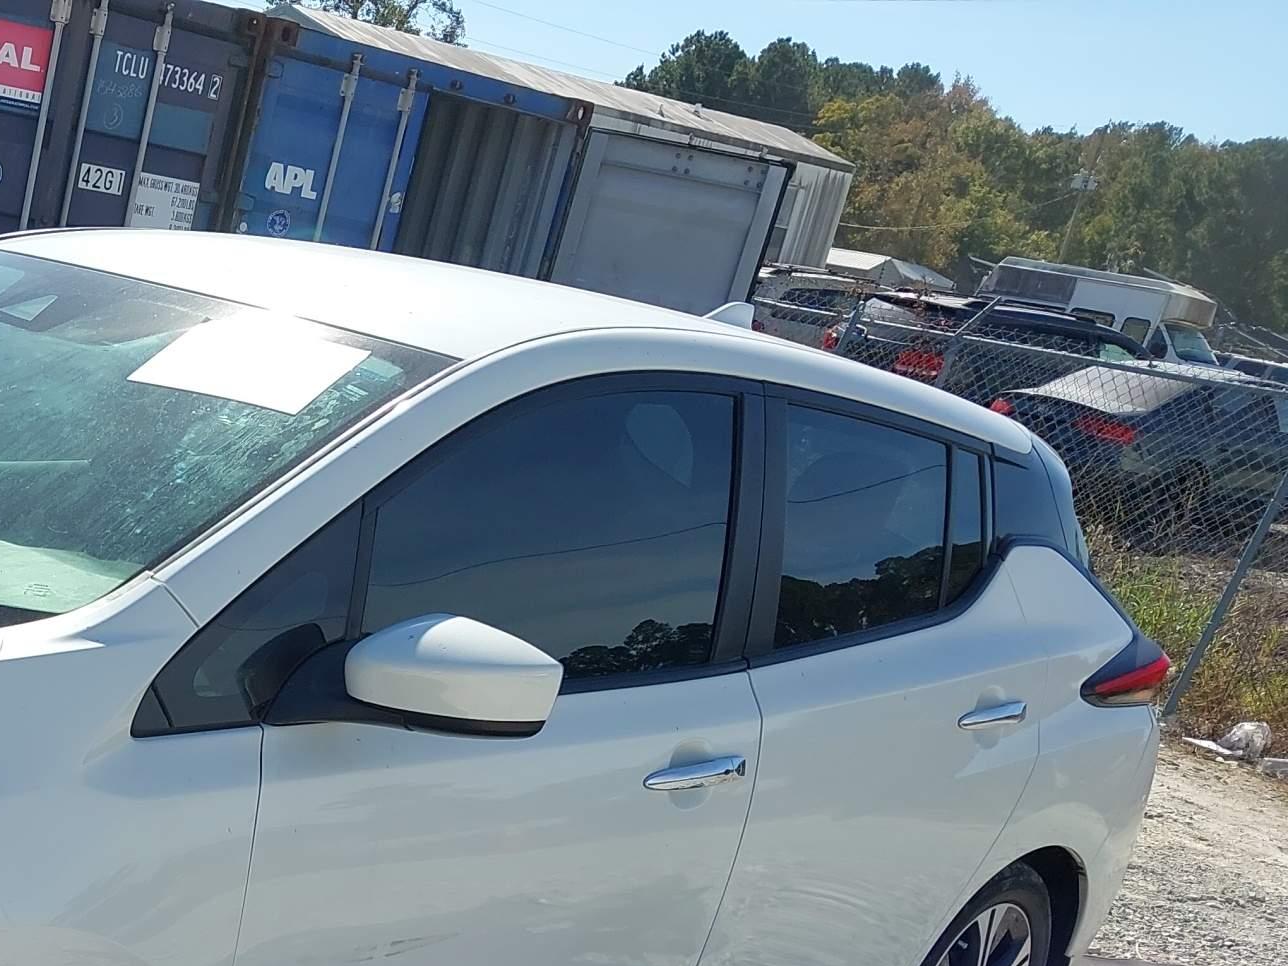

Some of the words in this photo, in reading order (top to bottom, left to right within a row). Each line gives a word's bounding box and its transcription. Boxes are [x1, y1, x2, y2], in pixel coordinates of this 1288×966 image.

[115, 51, 149, 79] TCLU
[209, 76, 221, 99] 2
[81, 166, 123, 193] 42G1
[265, 162, 318, 200] APL
